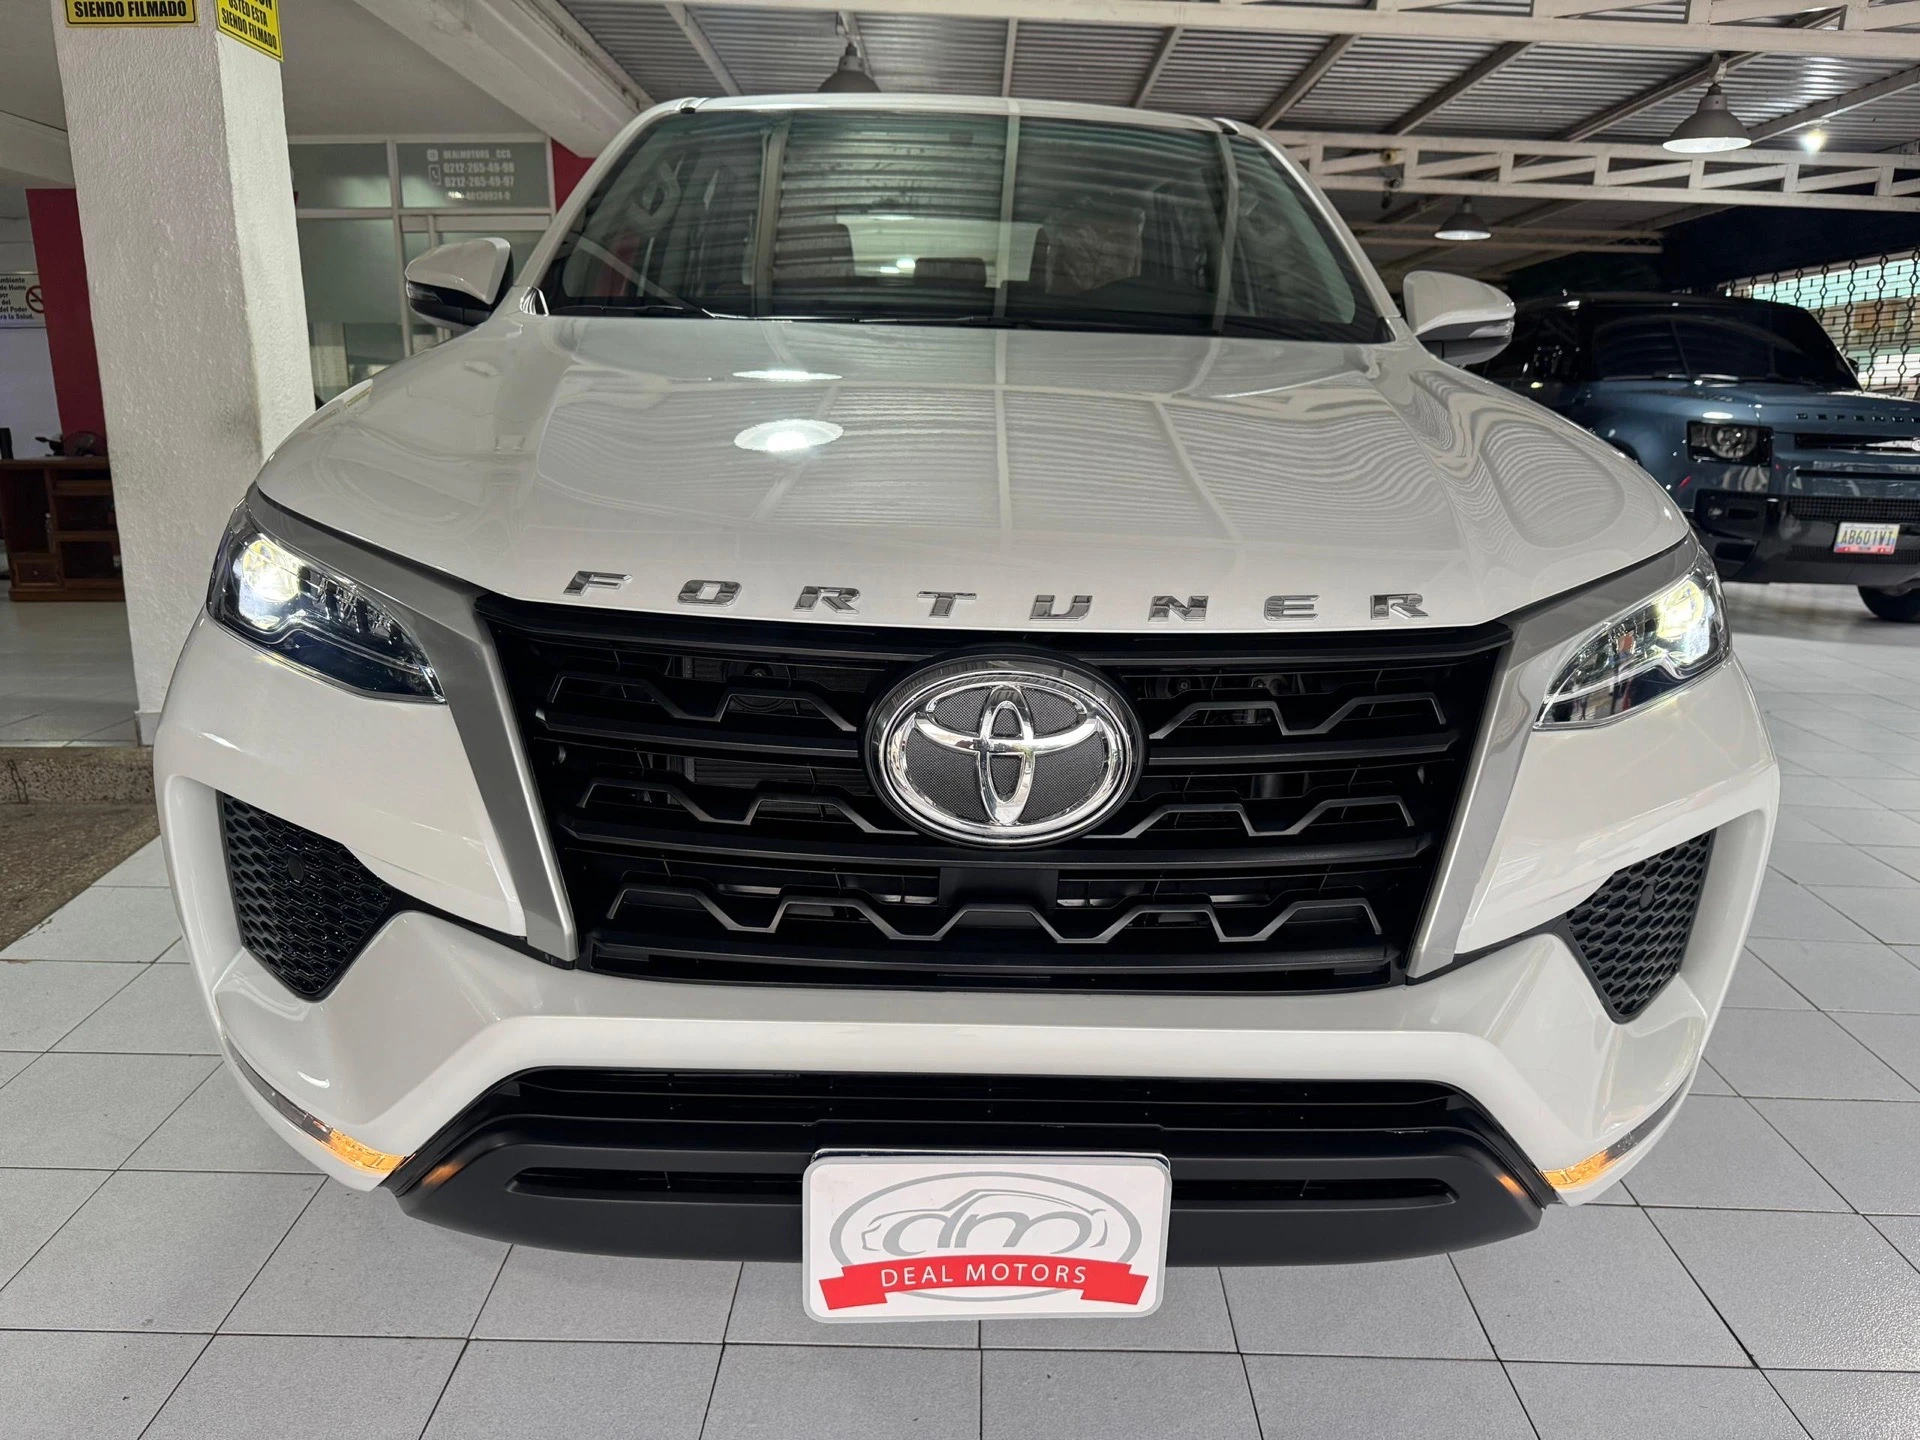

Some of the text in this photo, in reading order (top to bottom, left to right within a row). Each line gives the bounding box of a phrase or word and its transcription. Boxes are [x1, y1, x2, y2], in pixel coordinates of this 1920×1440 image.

[74, 1, 187, 18] SIENDO FILMADO
[228, 0, 251, 18] USTED
[250, 5, 268, 28] ESTA
[221, 7, 278, 50] SIENDO FILMADO
[562, 570, 1430, 622] FORTUNER
[880, 1262, 1088, 1288] DEAL MOTORS
